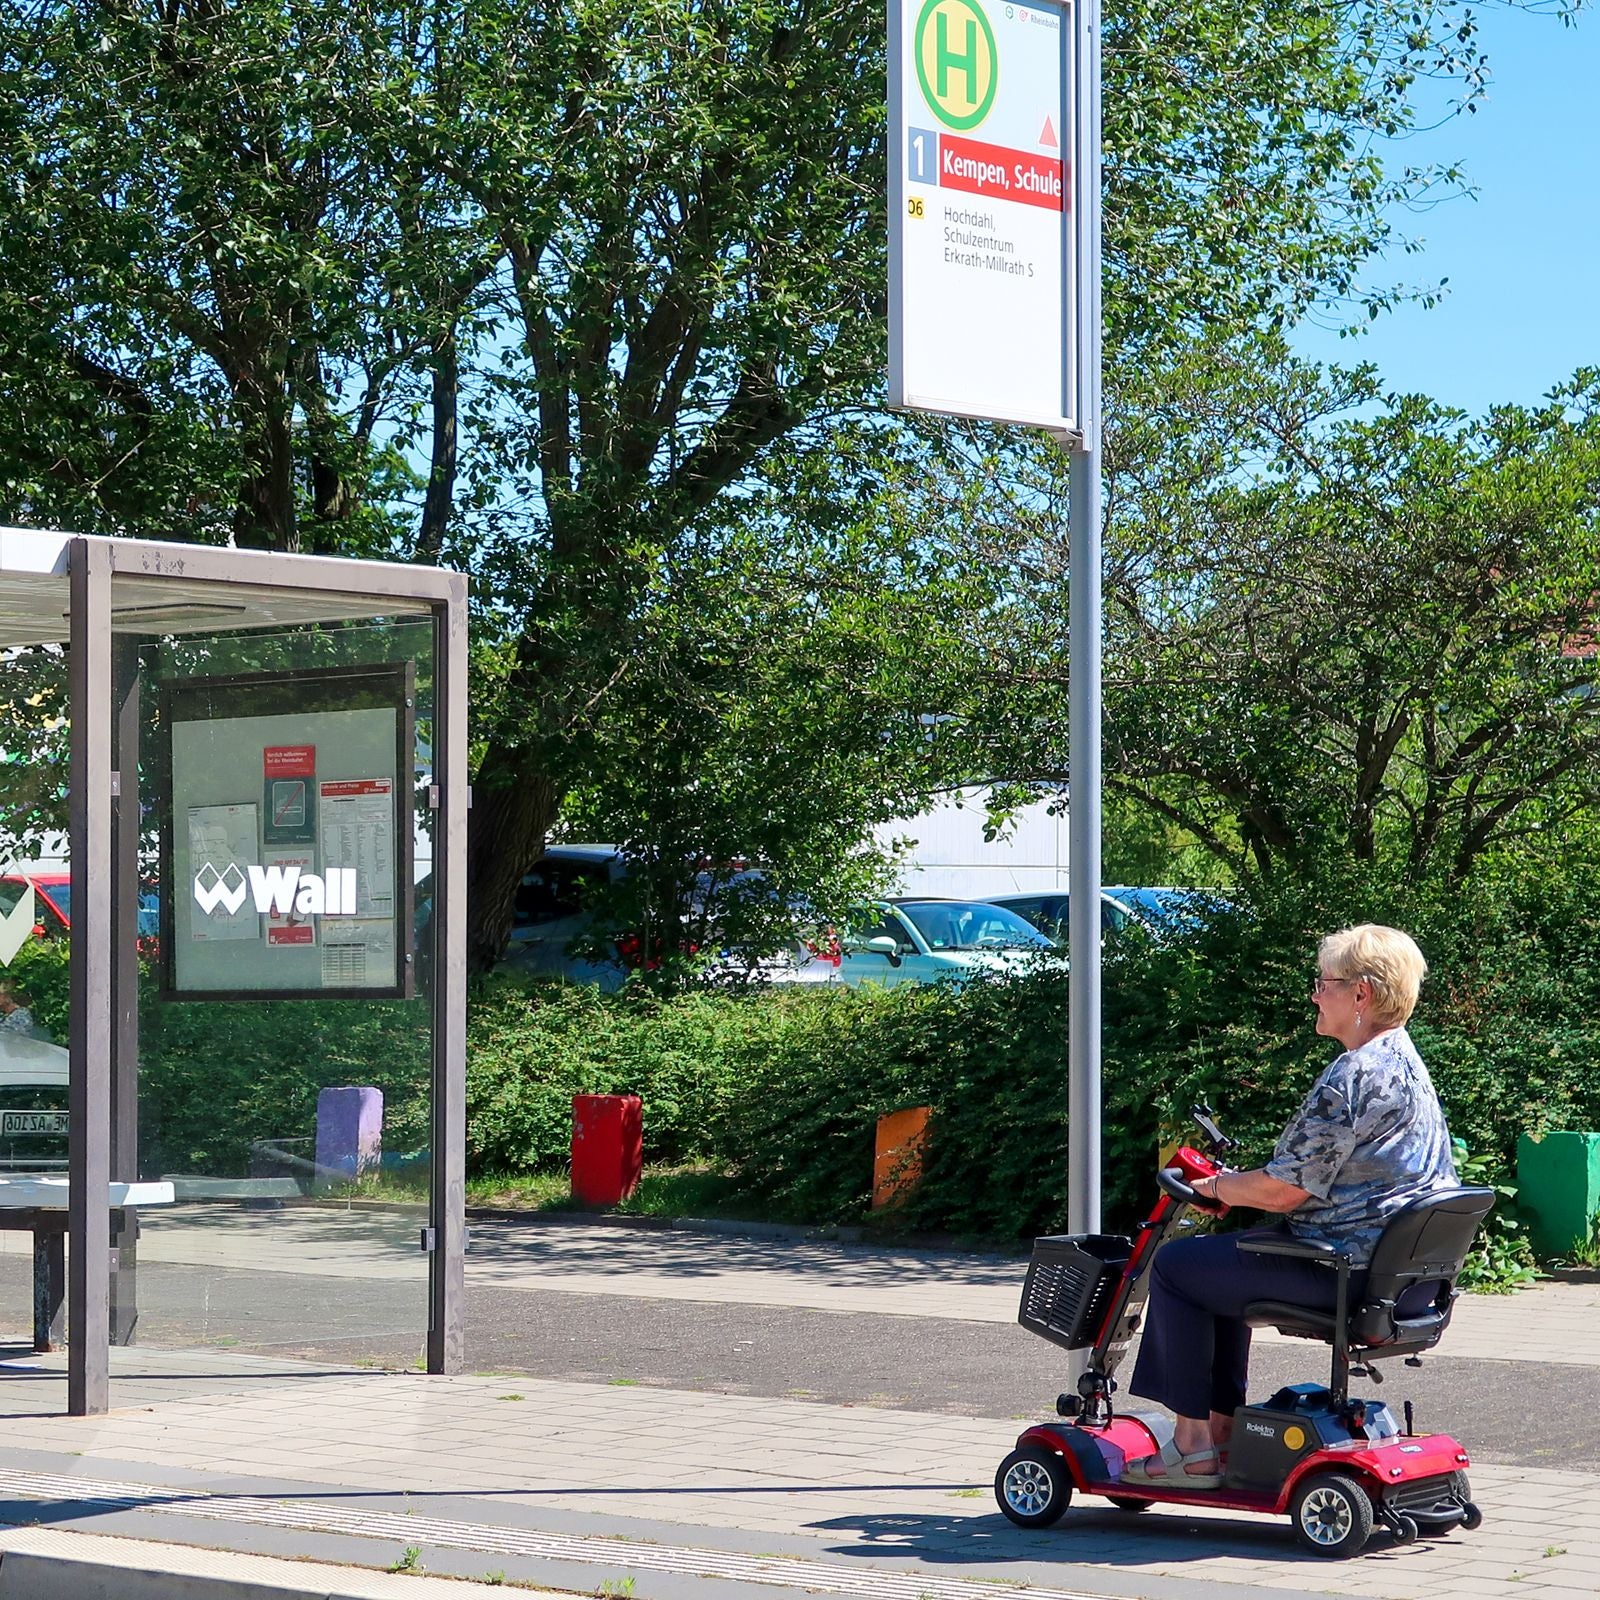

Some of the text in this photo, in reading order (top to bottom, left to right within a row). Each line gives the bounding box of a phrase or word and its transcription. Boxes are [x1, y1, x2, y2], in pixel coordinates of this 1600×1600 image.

[936, 11, 977, 105] H
[912, 135, 924, 177] 1
[943, 149, 1062, 198] Kempen, Schule
[944, 206, 996, 233] Hochdahl,
[944, 226, 1014, 254] Schulzentrum
[944, 247, 1034, 278] Erkrath-Millrath S
[247, 865, 357, 915] Wall
[1246, 1422, 1275, 1434] Rolektro
